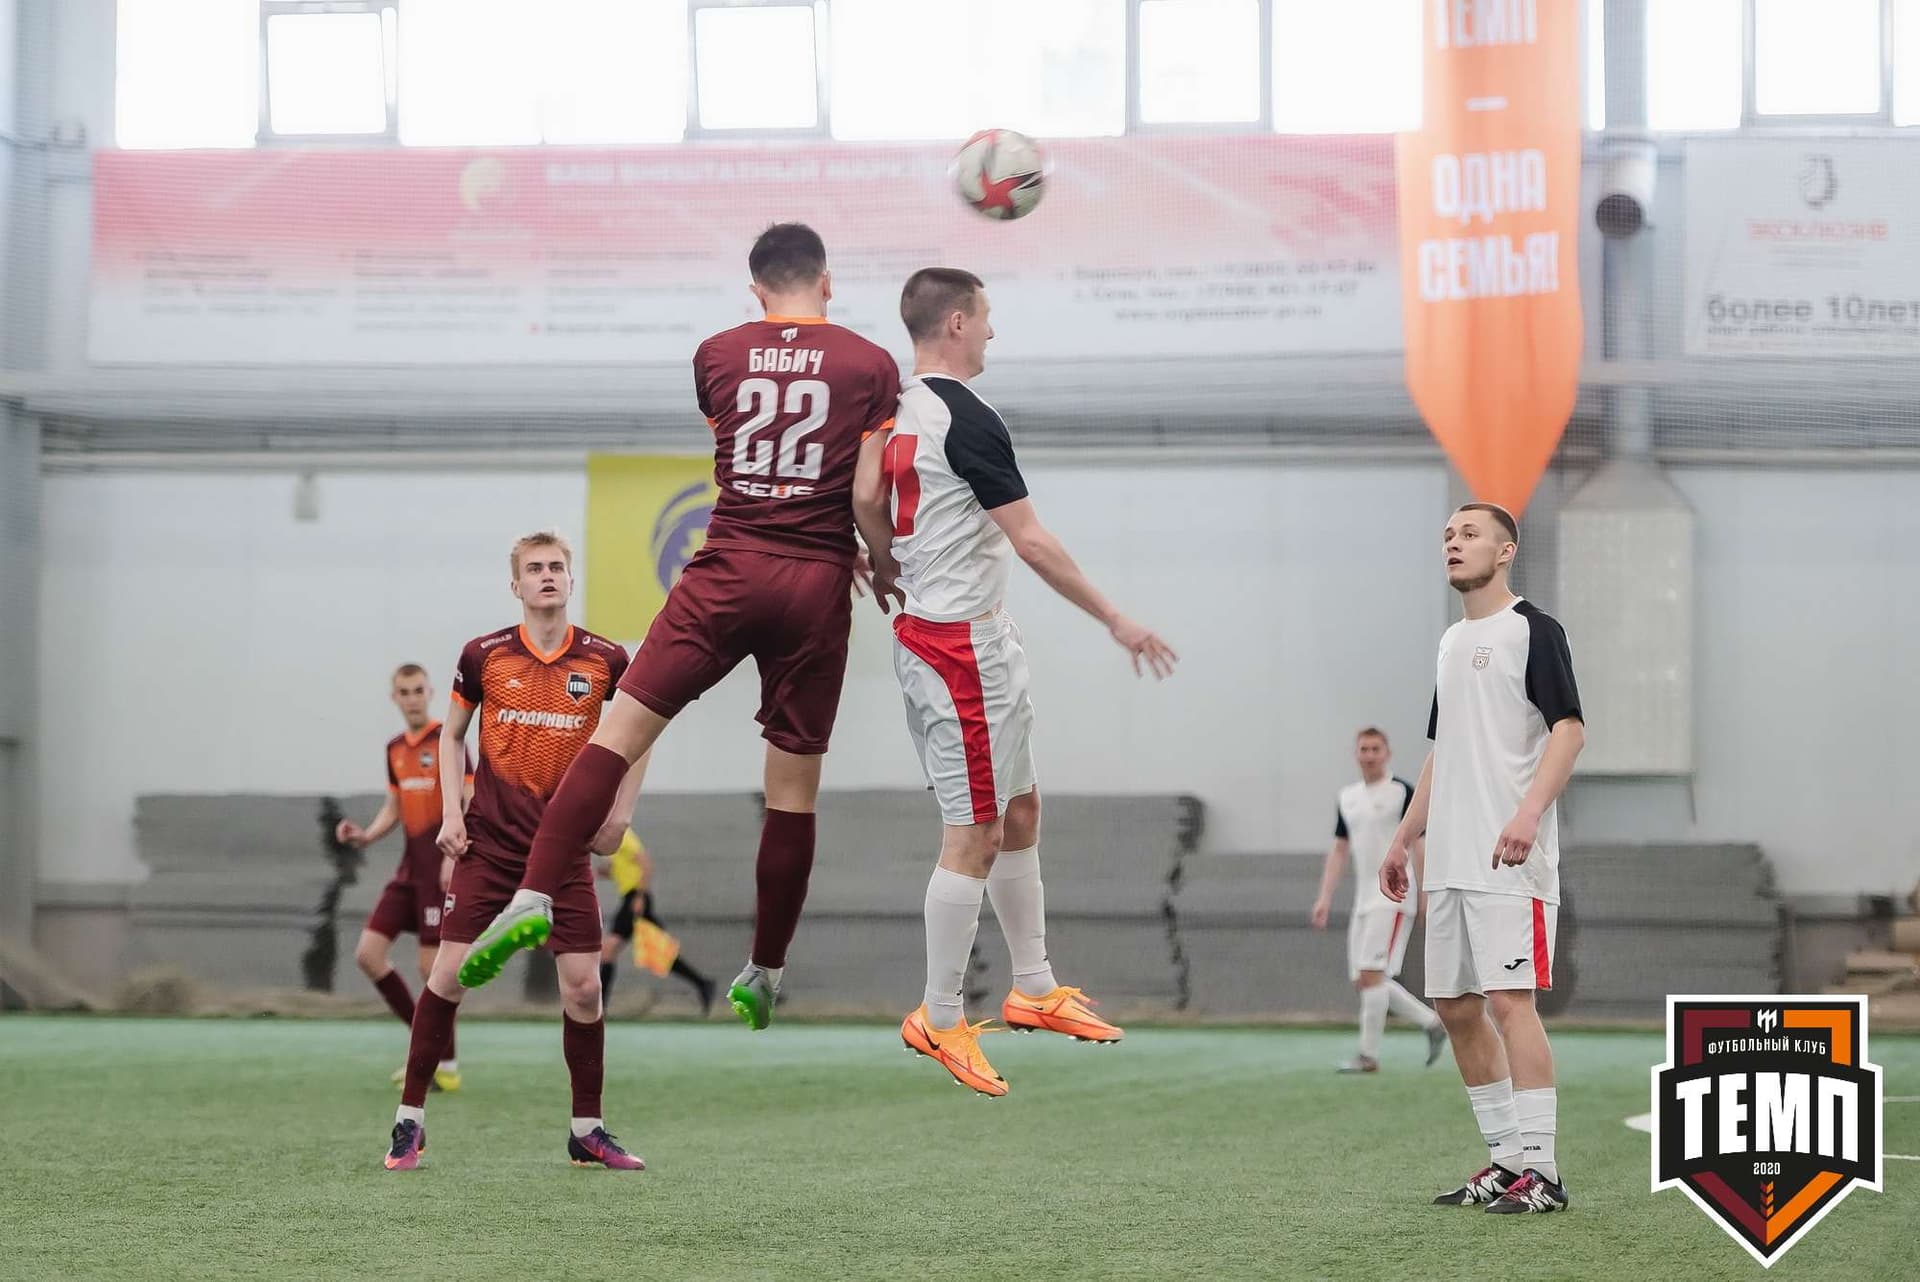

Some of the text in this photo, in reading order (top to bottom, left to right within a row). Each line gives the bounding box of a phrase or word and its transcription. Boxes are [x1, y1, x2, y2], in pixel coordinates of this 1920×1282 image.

[1432, 150, 1546, 224] ОДНА
[1419, 233, 1560, 302] СЕМЬЯ!
[749, 348, 825, 374] БАБИЧ
[731, 377, 831, 480] 22
